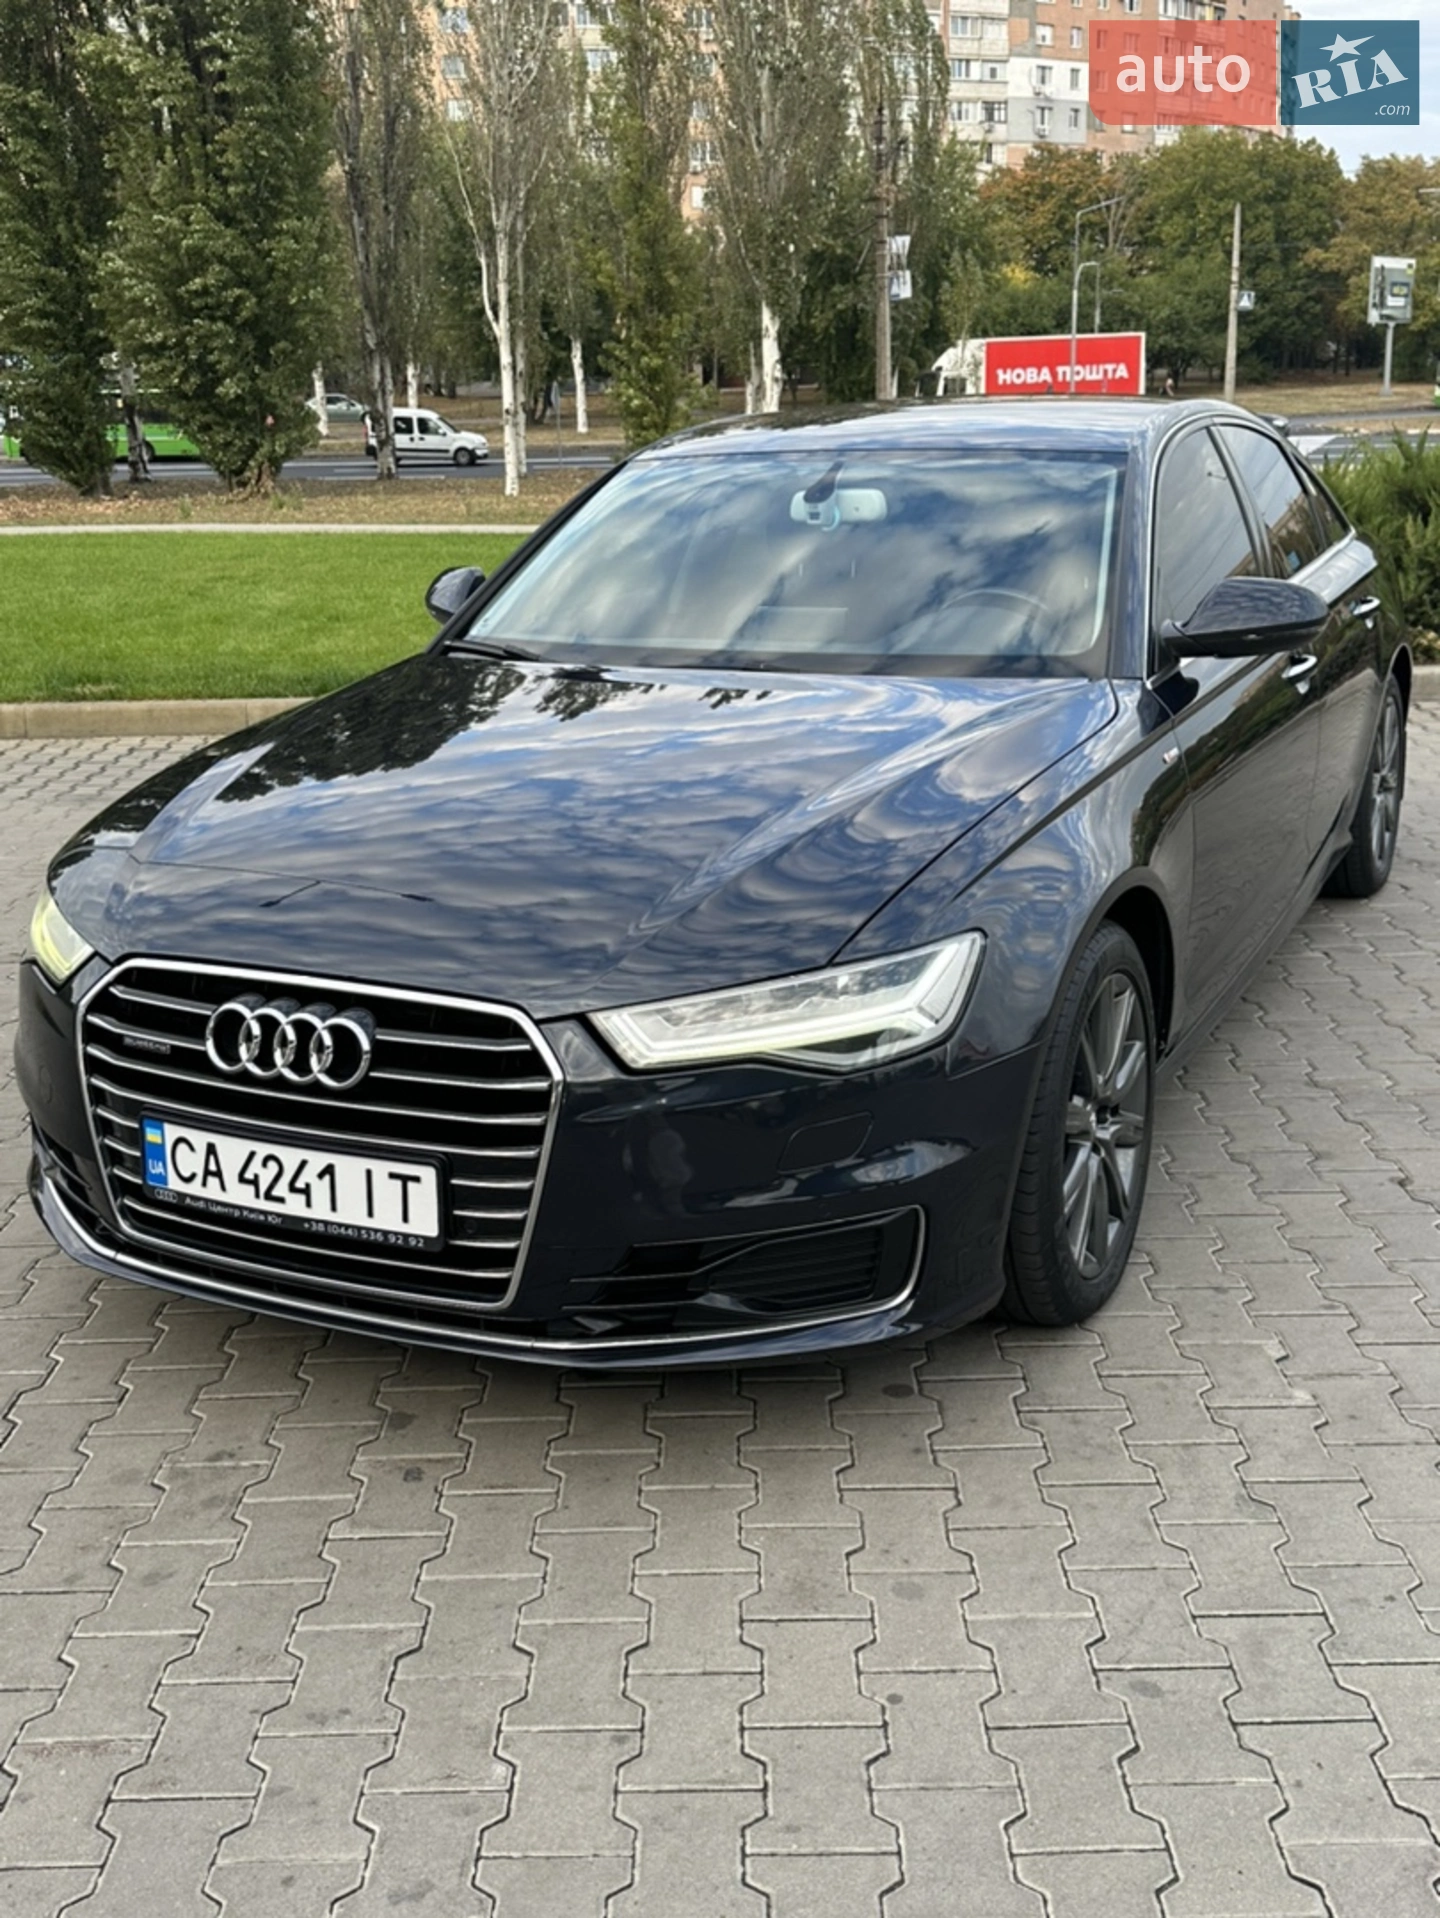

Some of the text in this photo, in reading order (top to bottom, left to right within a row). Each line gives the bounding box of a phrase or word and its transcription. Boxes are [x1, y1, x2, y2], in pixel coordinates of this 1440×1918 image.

[996, 362, 1129, 385] НОВА ПОШТА
[148, 1158, 168, 1177] UA
[171, 1136, 422, 1224] CA 4241 IT
[360, 1229, 384, 1242] 536
[387, 1233, 404, 1245] 92
[408, 1237, 424, 1247] 92
